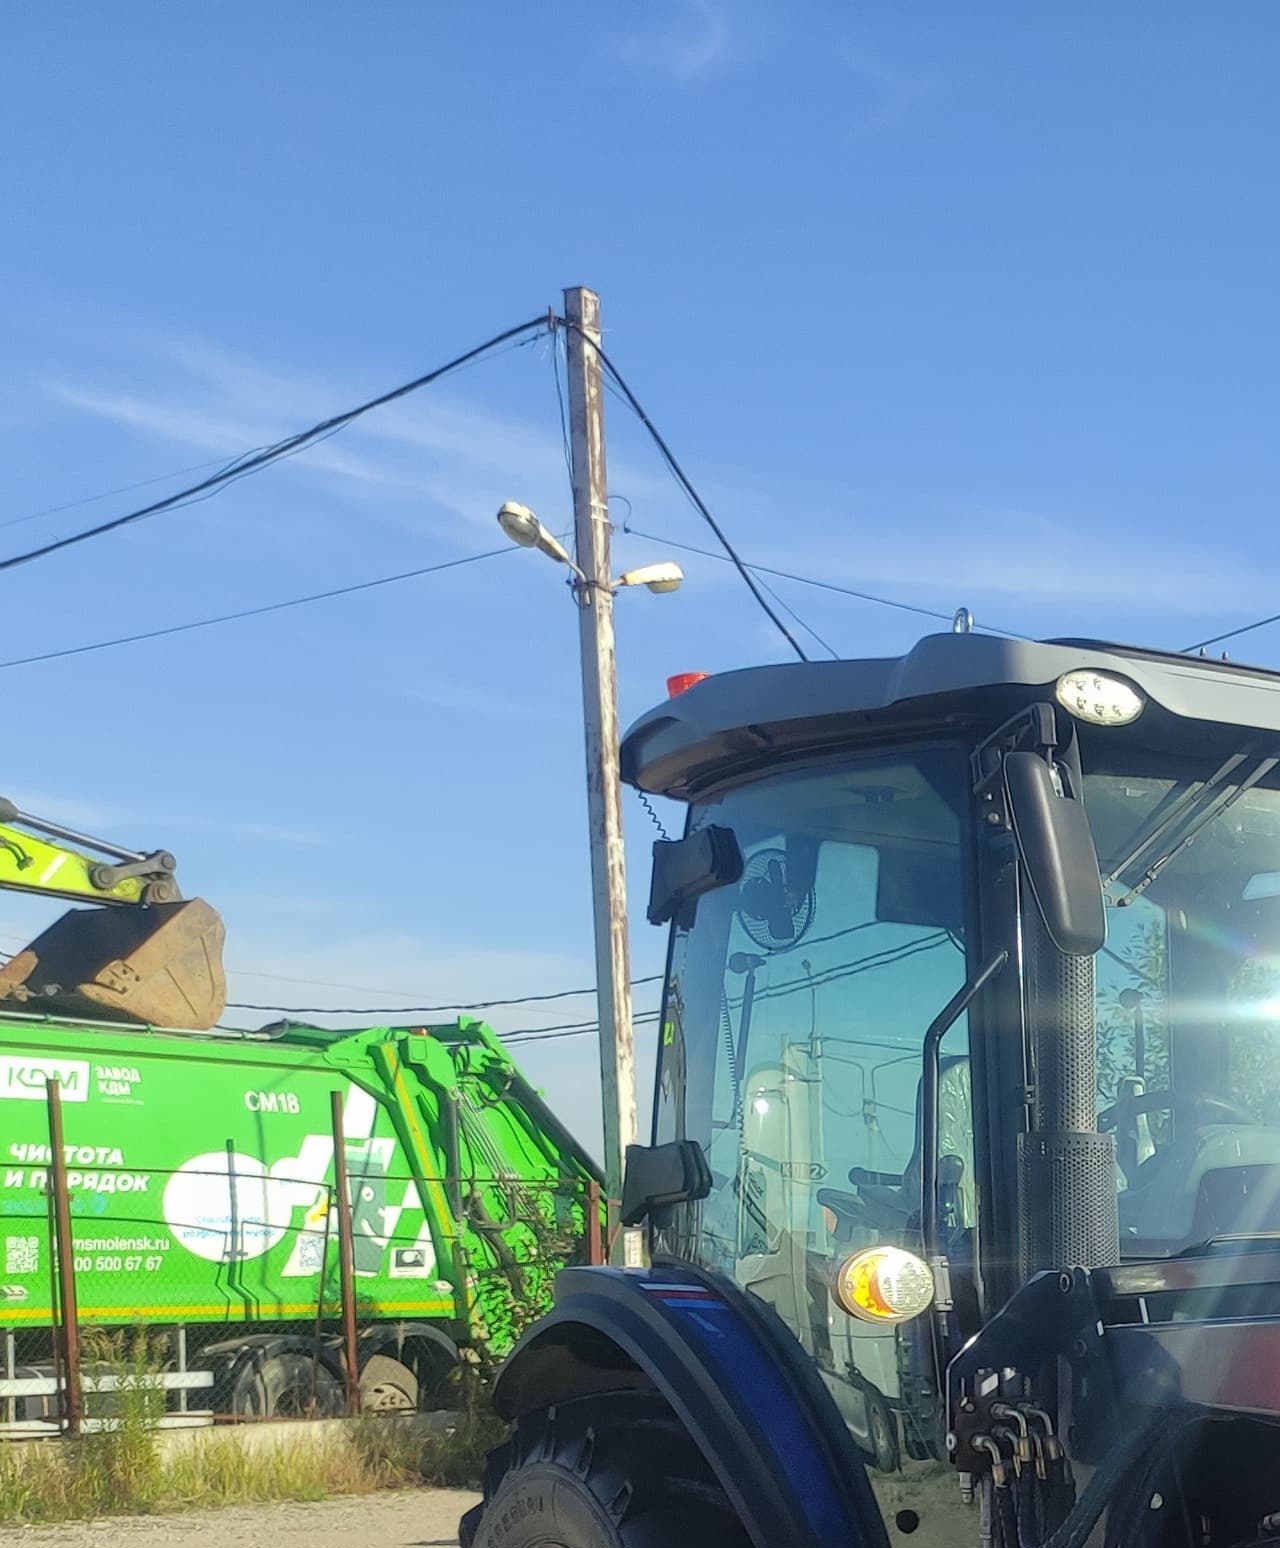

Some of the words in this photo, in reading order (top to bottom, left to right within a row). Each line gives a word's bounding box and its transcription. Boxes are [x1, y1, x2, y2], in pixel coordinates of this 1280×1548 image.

[8, 1066, 79, 1090] KDM
[95, 1065, 142, 1083] ЗАВОД
[98, 1080, 131, 1096] КДМ
[4, 1170, 24, 1189] И
[29, 1171, 150, 1193] ПРЯДОК
[53, 1236, 170, 1250] msmolensk.ru
[73, 1256, 92, 1271] 00
[95, 1256, 121, 1271] 500
[125, 1256, 143, 1271] 67
[145, 1256, 163, 1271] 67
